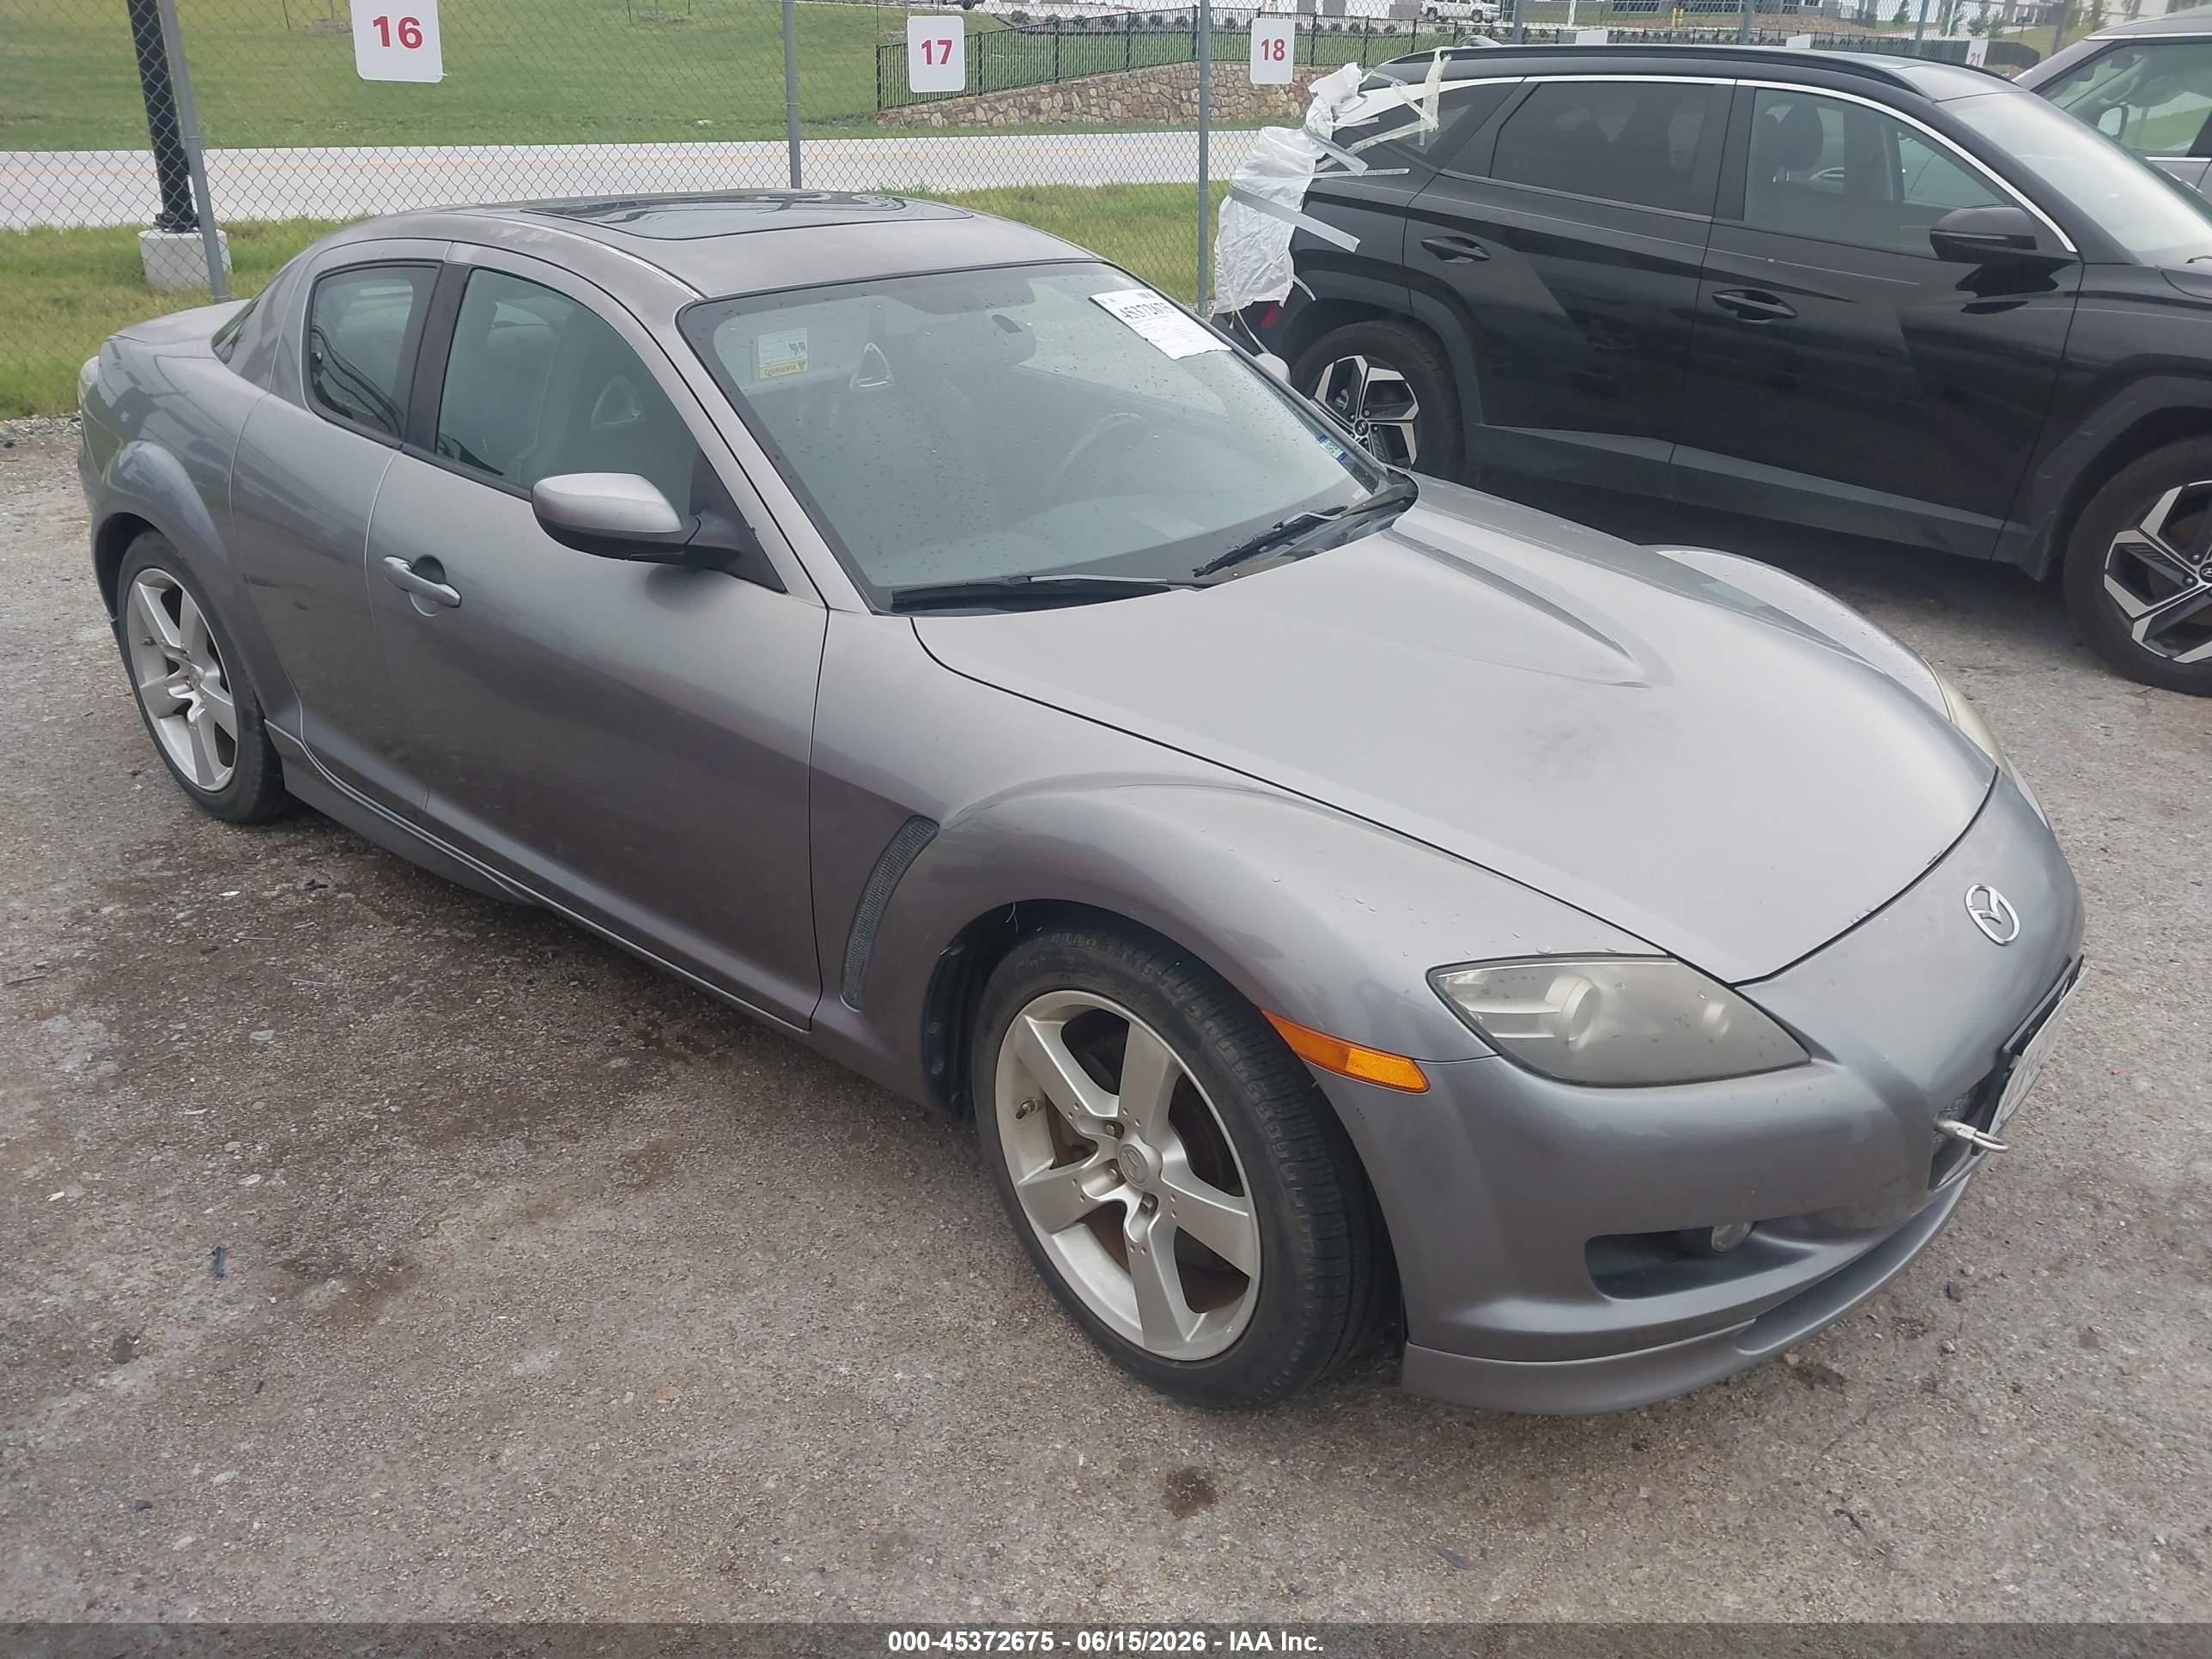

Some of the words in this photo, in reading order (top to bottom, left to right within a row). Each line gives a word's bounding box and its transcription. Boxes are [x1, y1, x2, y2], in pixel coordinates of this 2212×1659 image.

[373, 15, 423, 50] 16
[921, 39, 952, 65] 17
[1261, 38, 1285, 62] 18
[1119, 302, 1176, 319] 45372675
